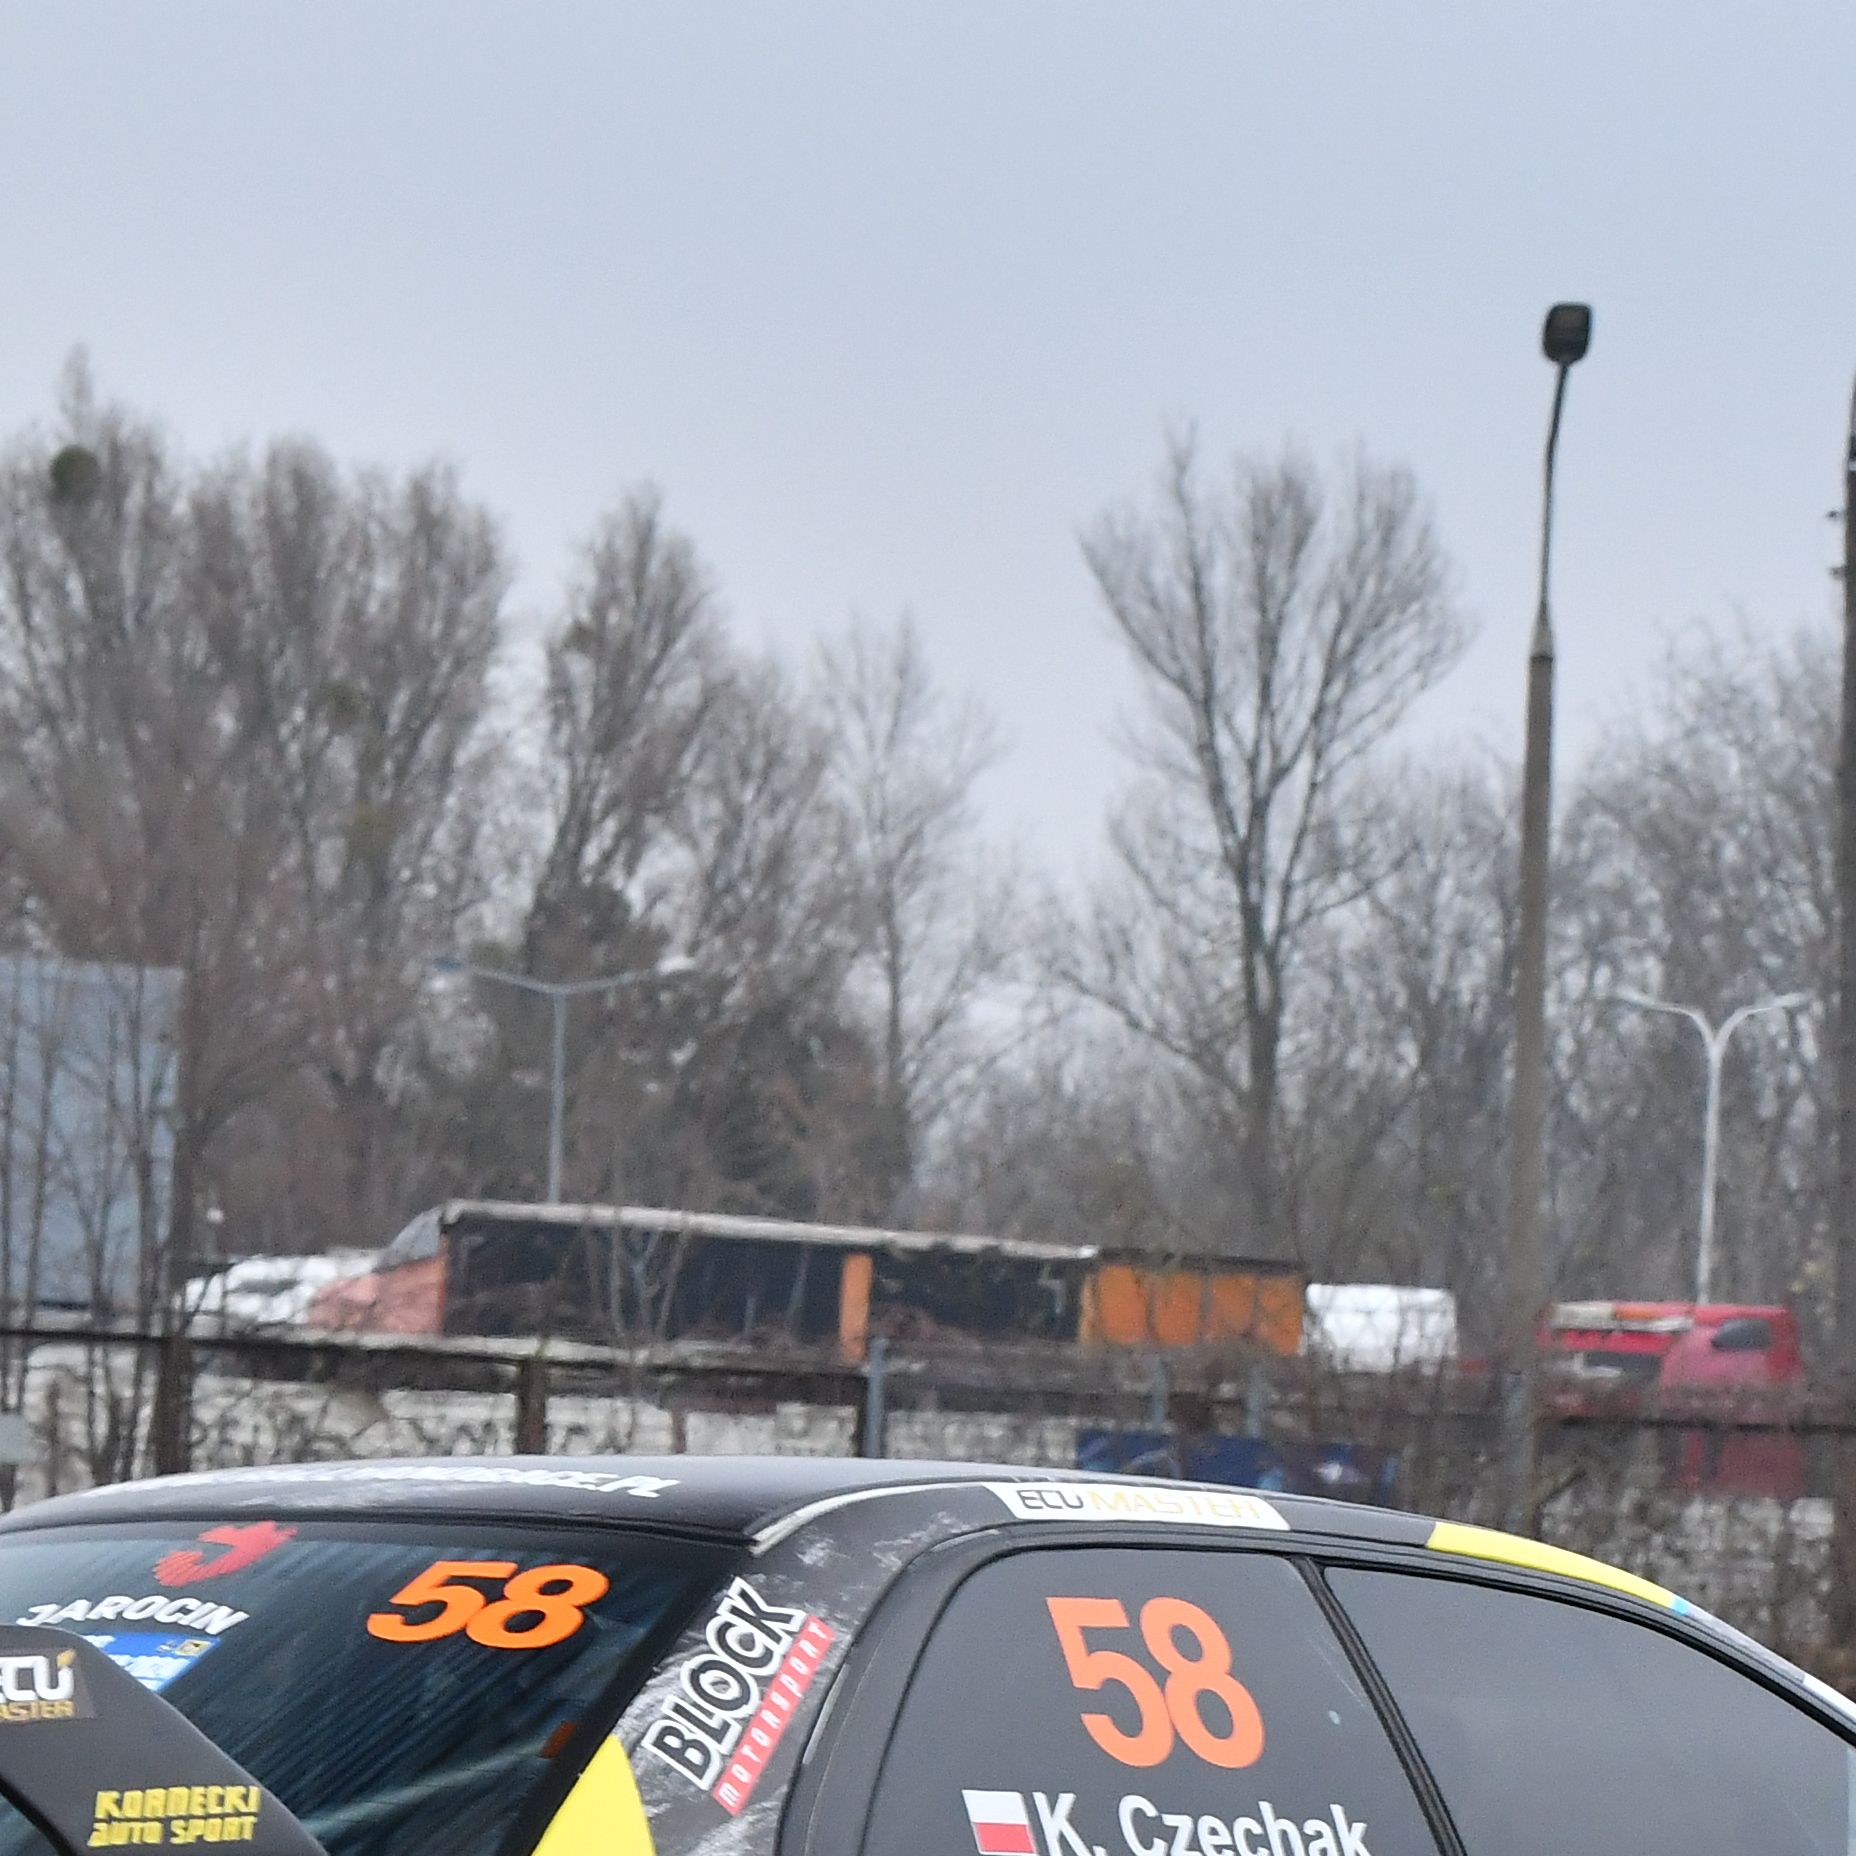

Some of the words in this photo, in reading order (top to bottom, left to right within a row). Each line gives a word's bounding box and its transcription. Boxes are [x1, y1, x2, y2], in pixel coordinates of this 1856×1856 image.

[16, 1595, 250, 1634] JAROCIN
[367, 1560, 610, 1649] 58
[642, 1576, 808, 1790] BLOCK
[1046, 1596, 1263, 1768] 58
[87, 1821, 162, 1846] AUTO
[169, 1816, 257, 1844] SPORT
[94, 1786, 261, 1818] KORNECKI
